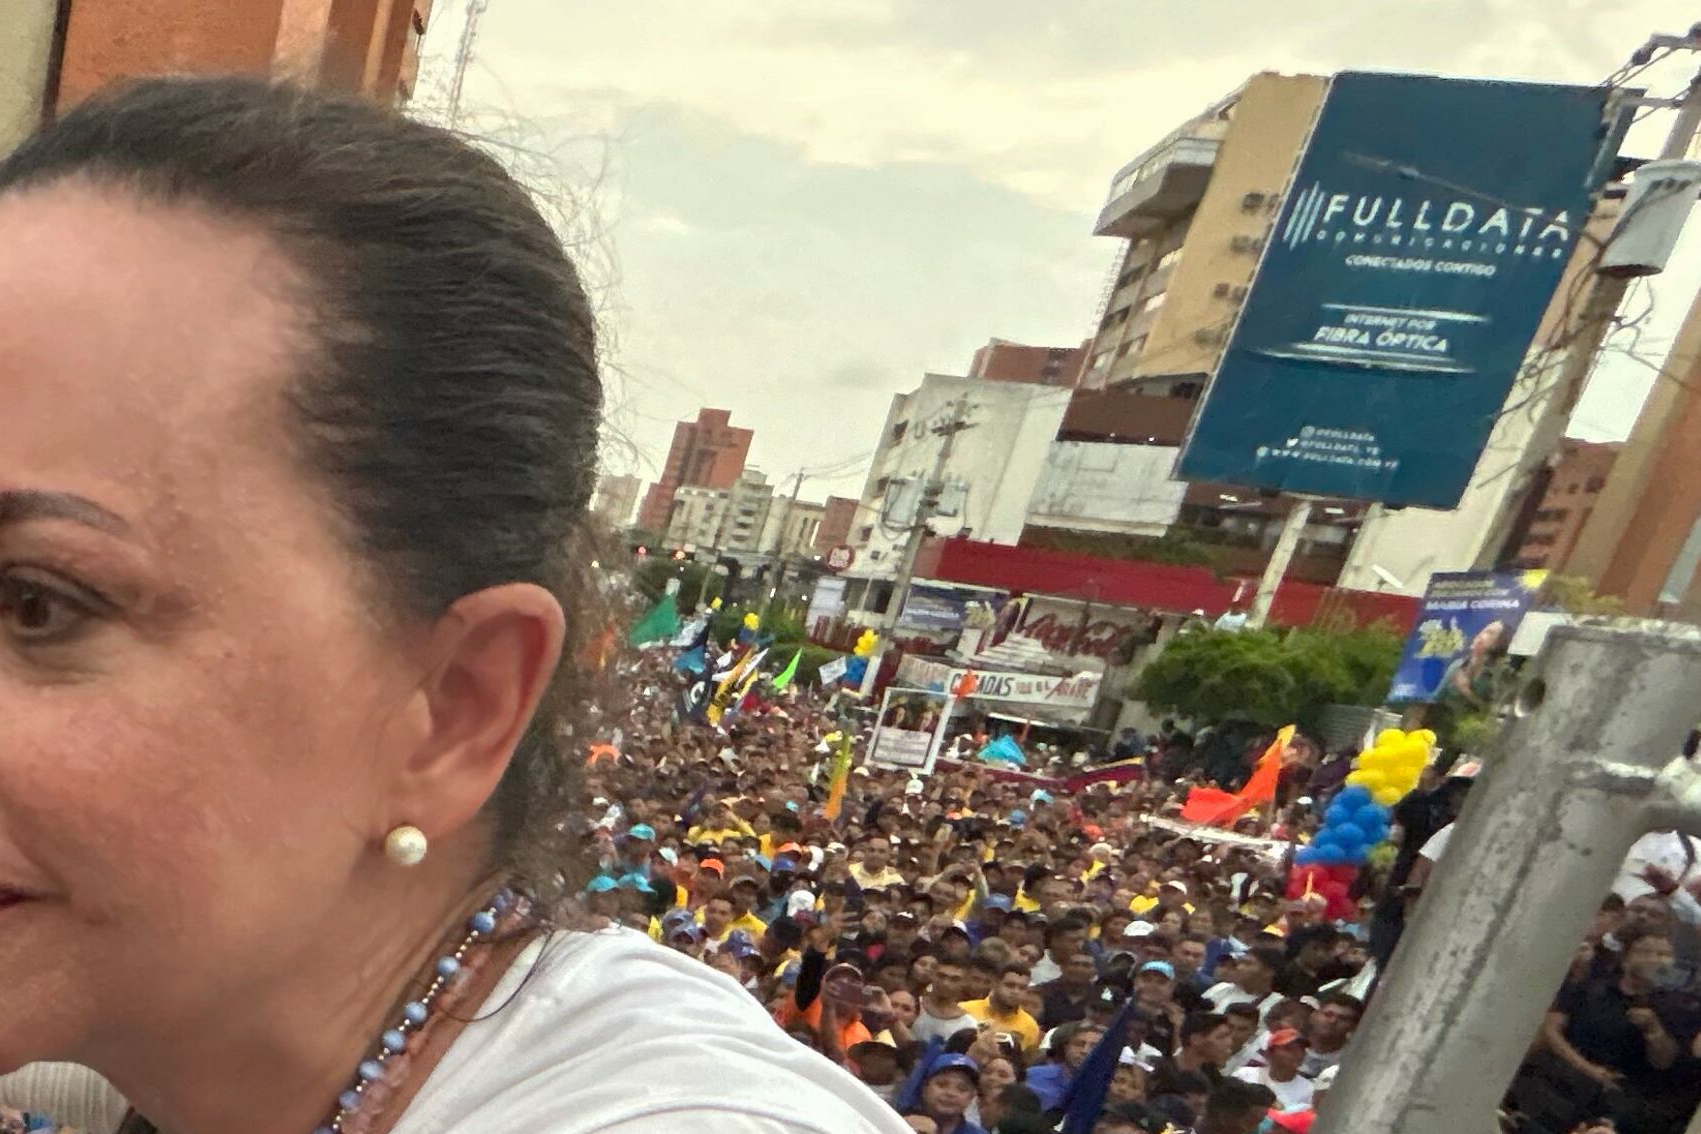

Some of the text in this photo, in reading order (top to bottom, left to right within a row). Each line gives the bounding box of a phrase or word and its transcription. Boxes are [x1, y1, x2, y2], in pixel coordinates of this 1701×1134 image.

[1323, 194, 1570, 242] FULLDATA
[1345, 254, 1497, 277] CONECTADOS CONTIGO
[1344, 313, 1407, 327] INTERNET
[1314, 326, 1448, 352] FIBRA ÓPTICA
